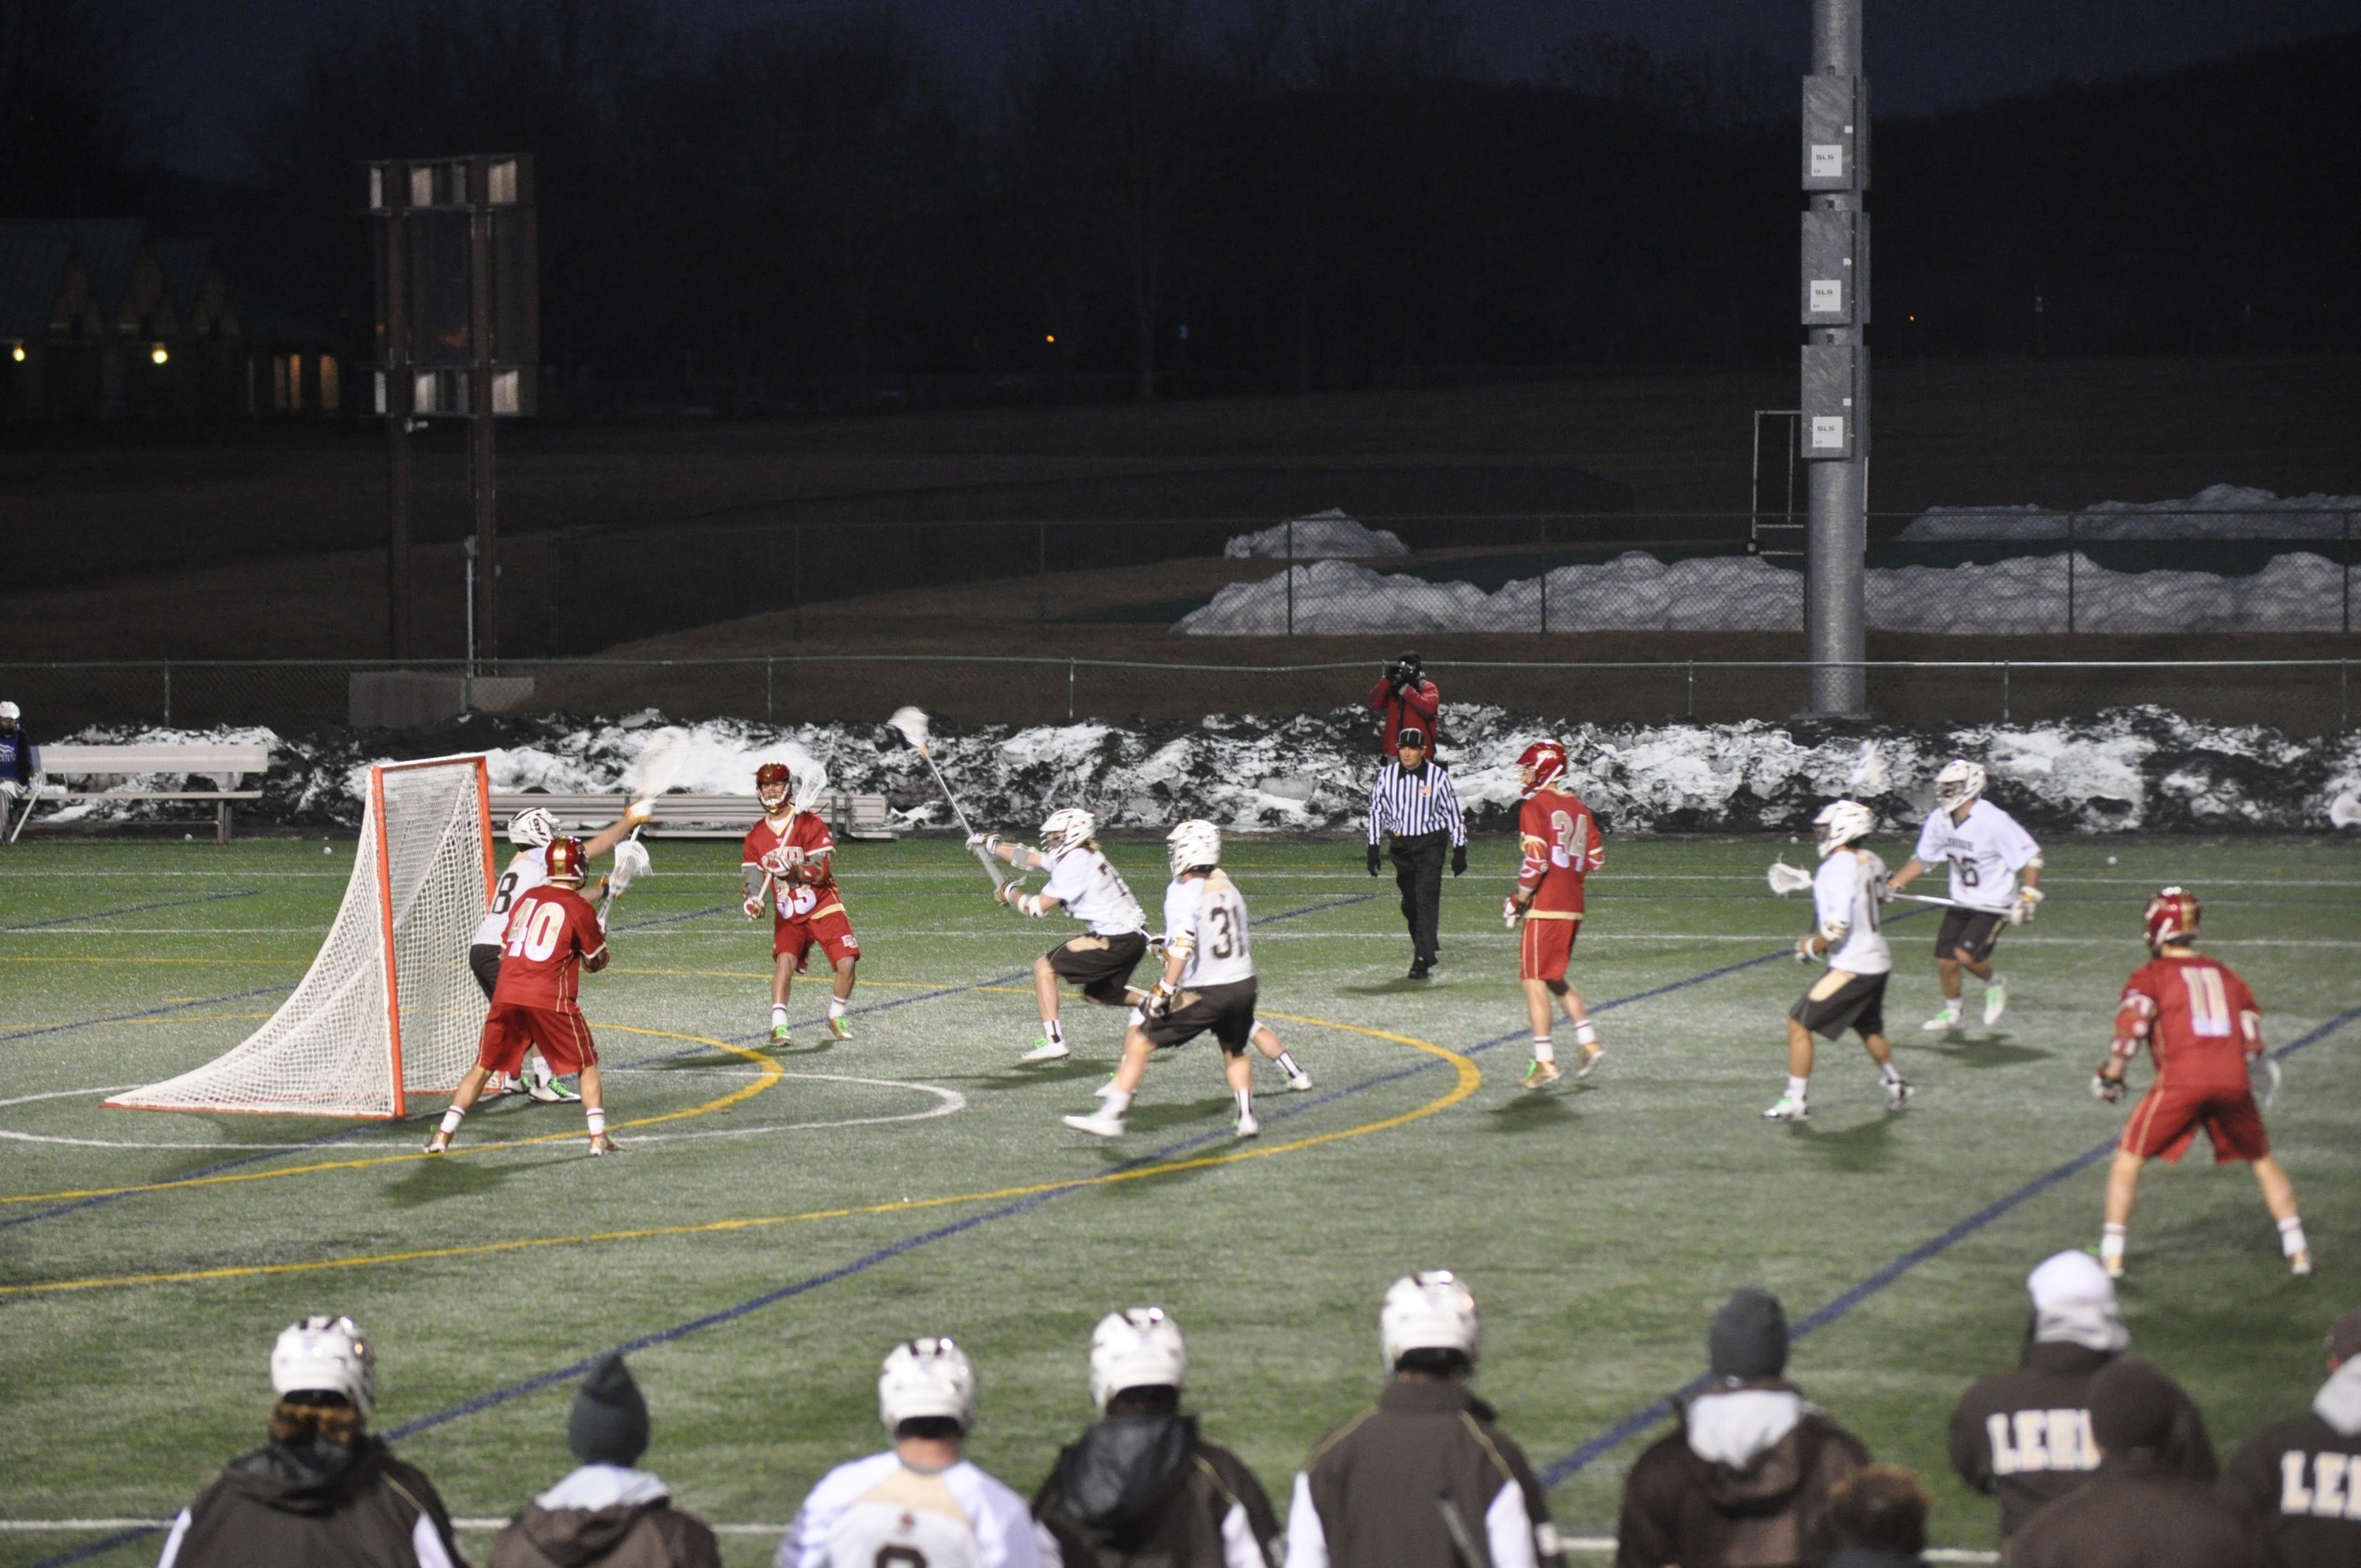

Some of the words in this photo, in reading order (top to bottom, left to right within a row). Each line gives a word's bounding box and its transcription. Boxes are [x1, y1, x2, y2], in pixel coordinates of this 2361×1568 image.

[1551, 810, 1587, 872] 34
[507, 897, 566, 962] 40
[1210, 905, 1243, 959] 31
[2179, 966, 2232, 1038] 11
